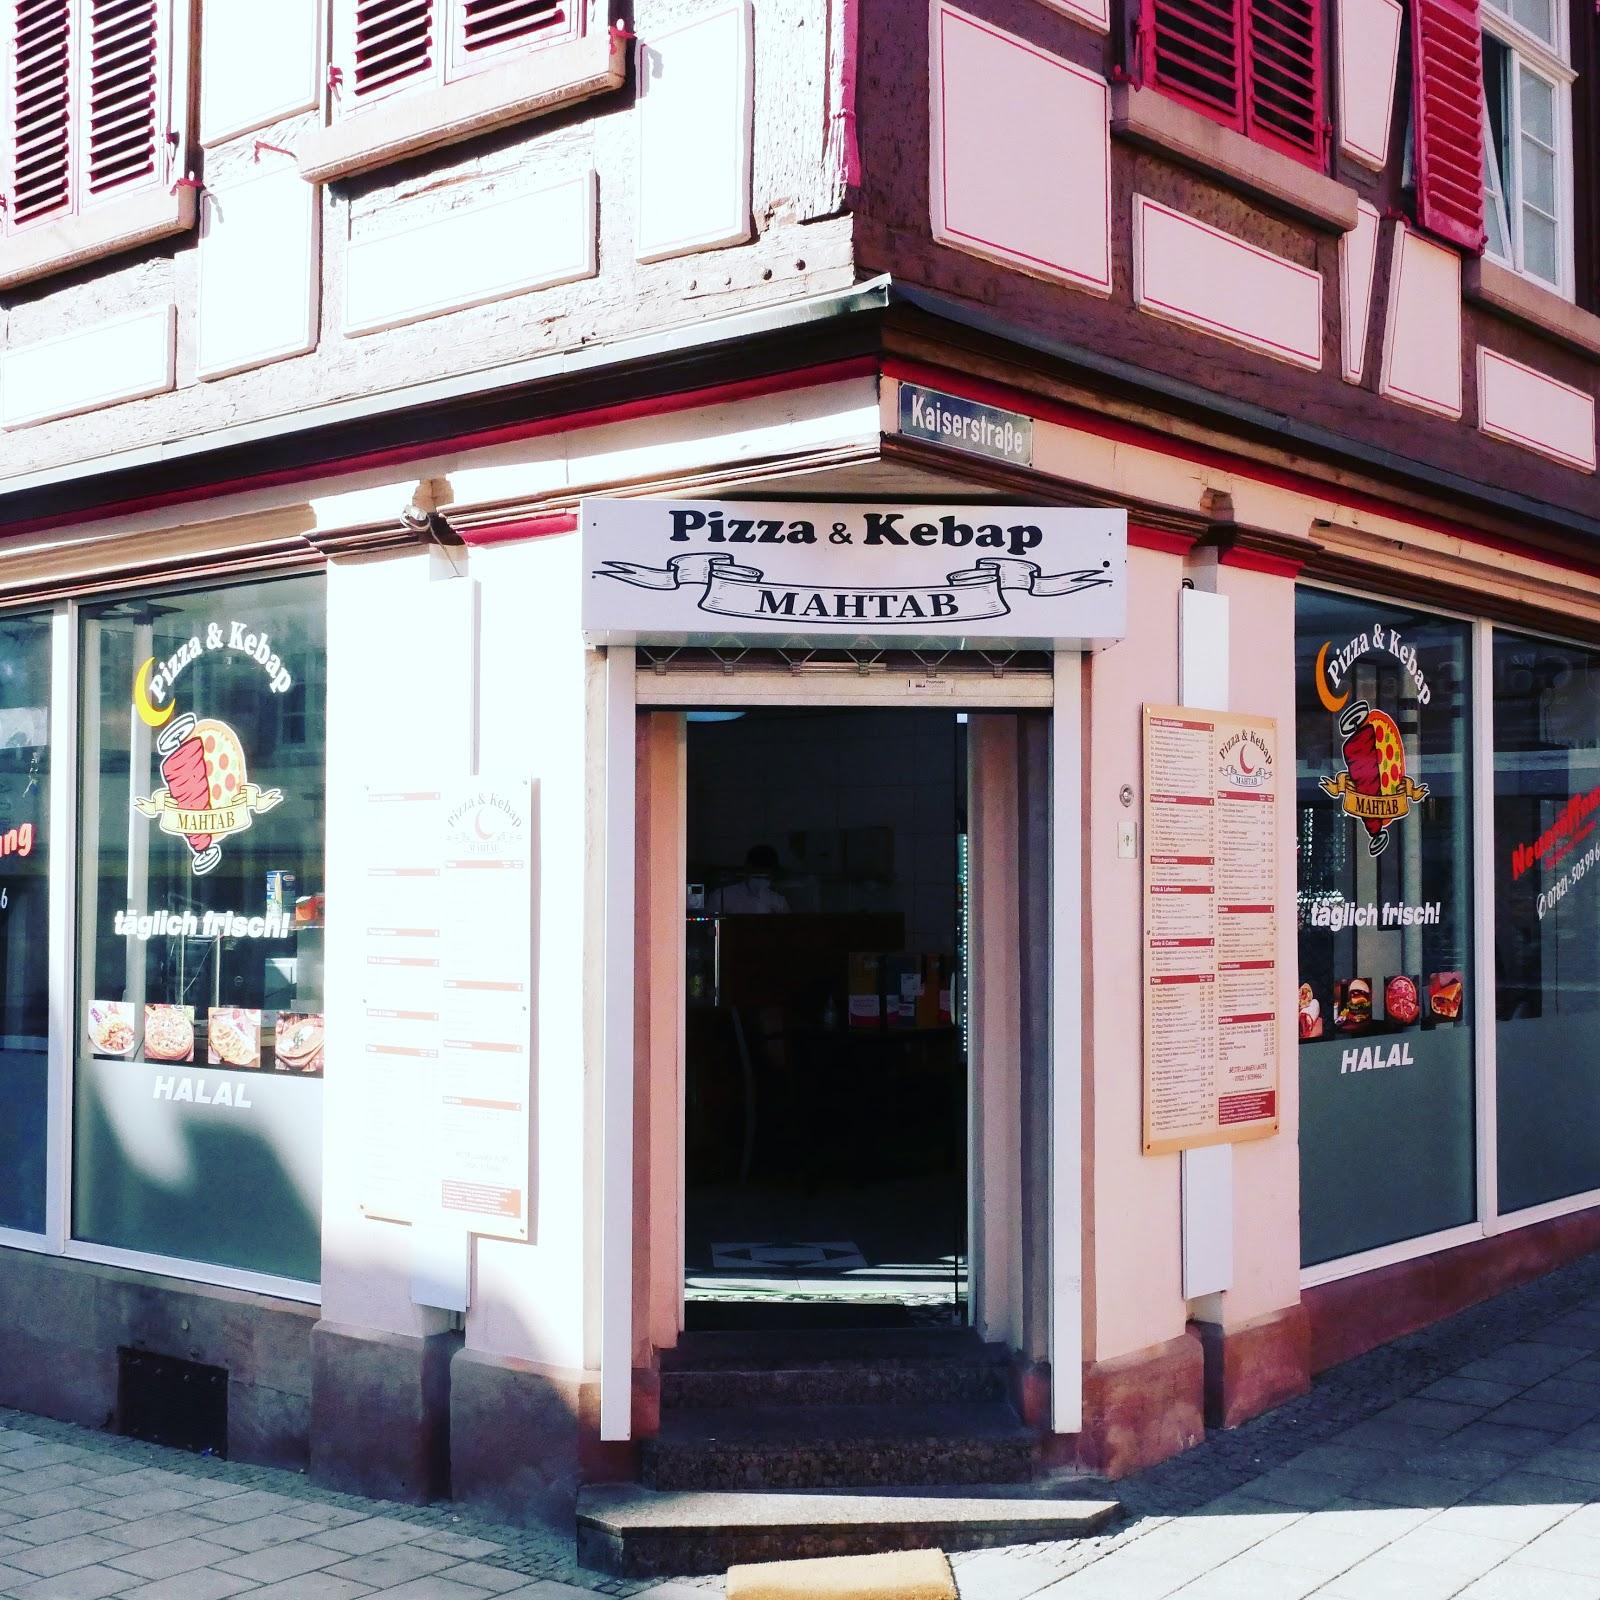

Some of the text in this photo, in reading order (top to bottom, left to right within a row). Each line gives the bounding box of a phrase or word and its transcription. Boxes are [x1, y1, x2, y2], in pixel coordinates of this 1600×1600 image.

[912, 394, 1023, 455] Kaiserstraße
[668, 510, 1043, 555] Pizza & Kebap
[755, 590, 959, 619] MAHTAB
[149, 621, 292, 703] Pizza & Kebap
[1327, 632, 1370, 688] Pizza
[1372, 623, 1385, 649] &
[1388, 628, 1431, 705] Kebap
[1219, 729, 1273, 765] Pizza & Kebap
[177, 811, 236, 831] MAHTAB
[1355, 796, 1399, 816] MAHTAB
[114, 909, 290, 940] täglich frisch!
[1310, 902, 1441, 932] täglich frisch!
[1341, 1043, 1414, 1074] HALAL
[152, 1075, 252, 1109] HALAL
